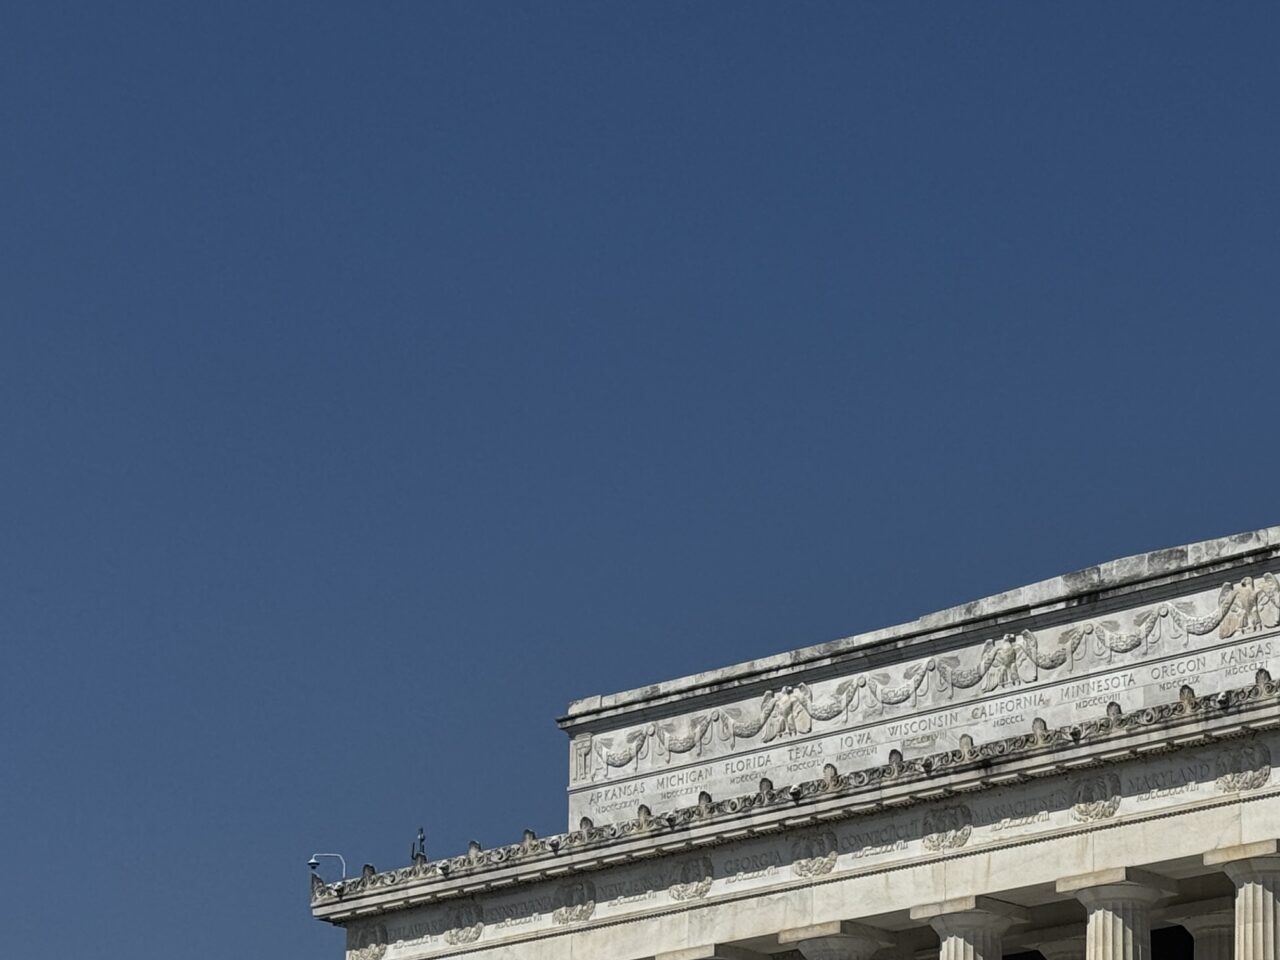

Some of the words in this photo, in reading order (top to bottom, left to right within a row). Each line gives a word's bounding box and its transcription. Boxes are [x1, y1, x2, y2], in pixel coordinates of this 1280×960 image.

[1220, 642, 1272, 666] KANSAS
[1150, 656, 1206, 681] OREGON
[1060, 673, 1136, 700] MINNESOTA
[971, 693, 1045, 720] CALIFORNIA
[888, 712, 959, 737] WISCONSIN
[787, 742, 823, 761] TEXAS
[840, 732, 873, 749] IOWA
[724, 754, 772, 775] FLORIDA
[656, 767, 713, 790] MICHIGAN
[1128, 763, 1210, 793] MARYLAND
[589, 782, 646, 806] ARKANSAS
[840, 820, 919, 850] CONNECTICUT
[724, 851, 782, 875] GEORGIA
